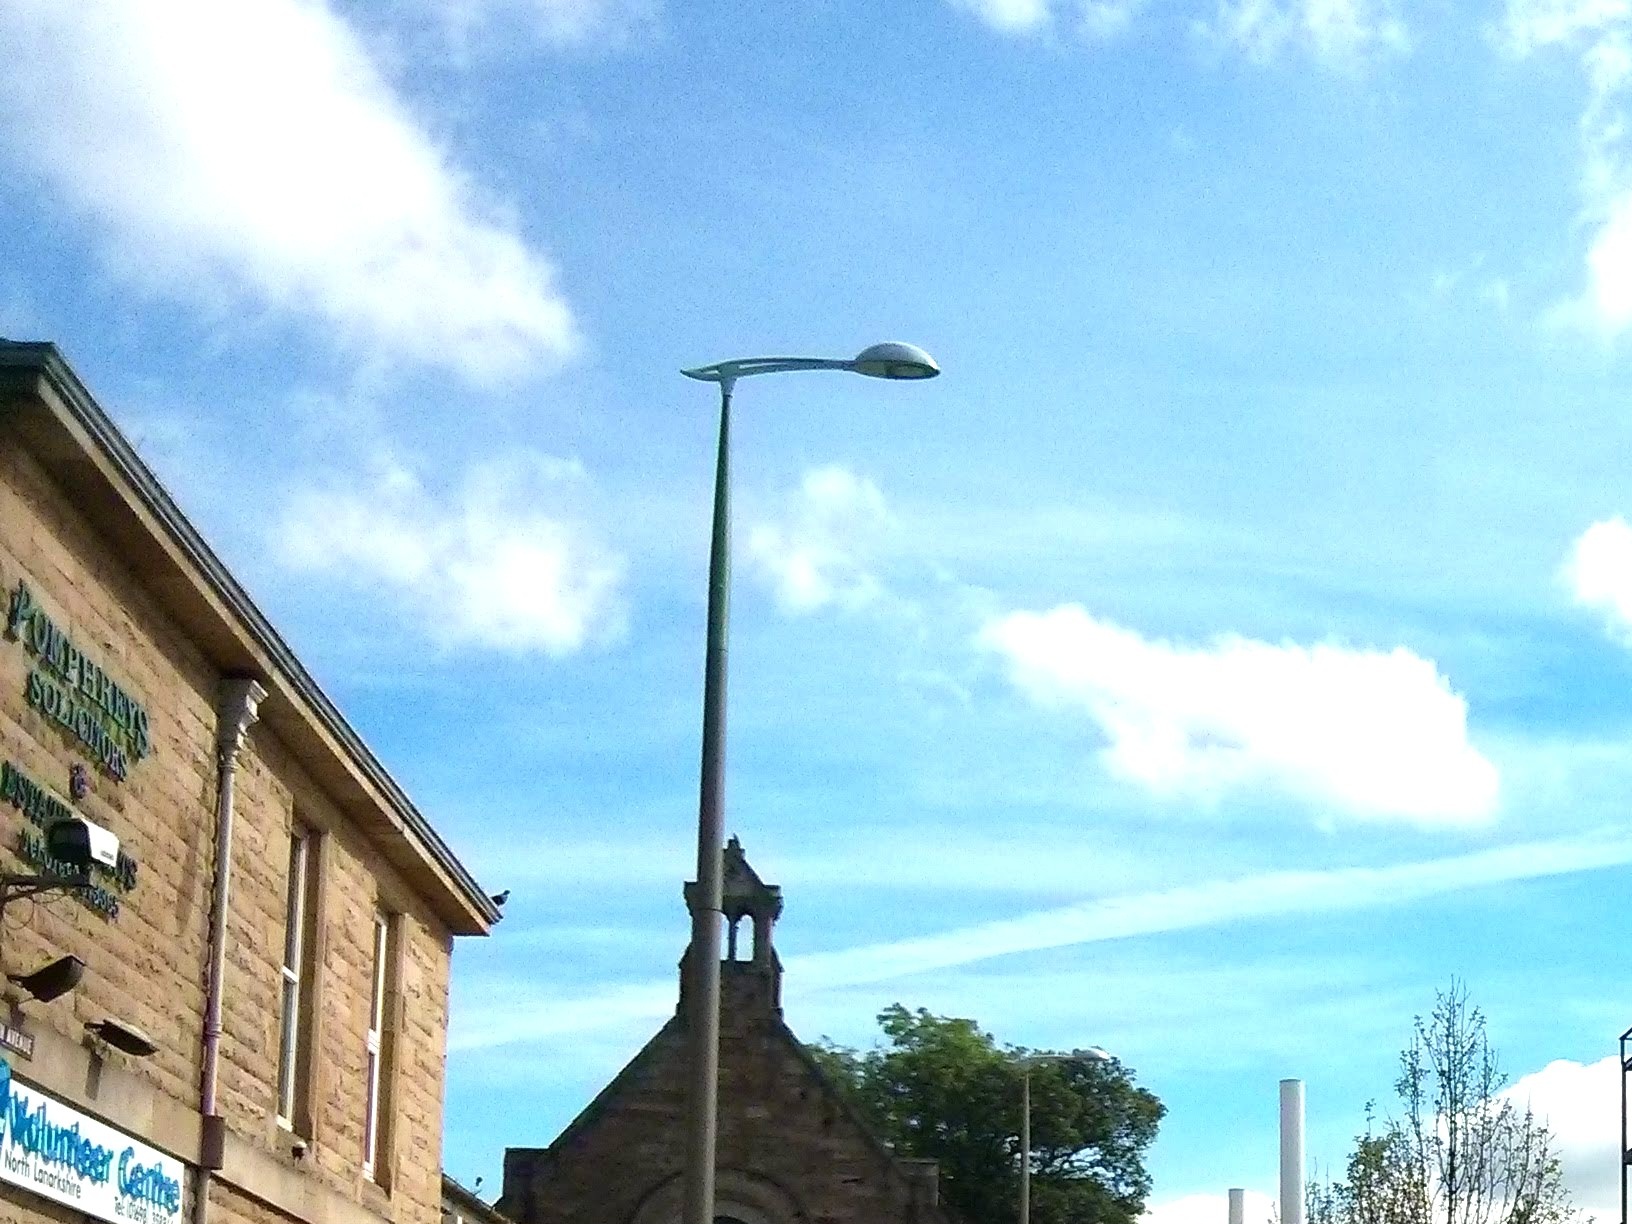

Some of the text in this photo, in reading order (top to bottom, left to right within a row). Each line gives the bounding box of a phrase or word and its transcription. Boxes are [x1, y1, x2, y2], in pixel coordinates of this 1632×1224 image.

[8, 578, 148, 760] POMPHREYS
[30, 670, 128, 782] SOLICITORS
[4, 1149, 82, 1199] North Lanarkshire
[9, 1090, 180, 1216] Volunteer Centre
